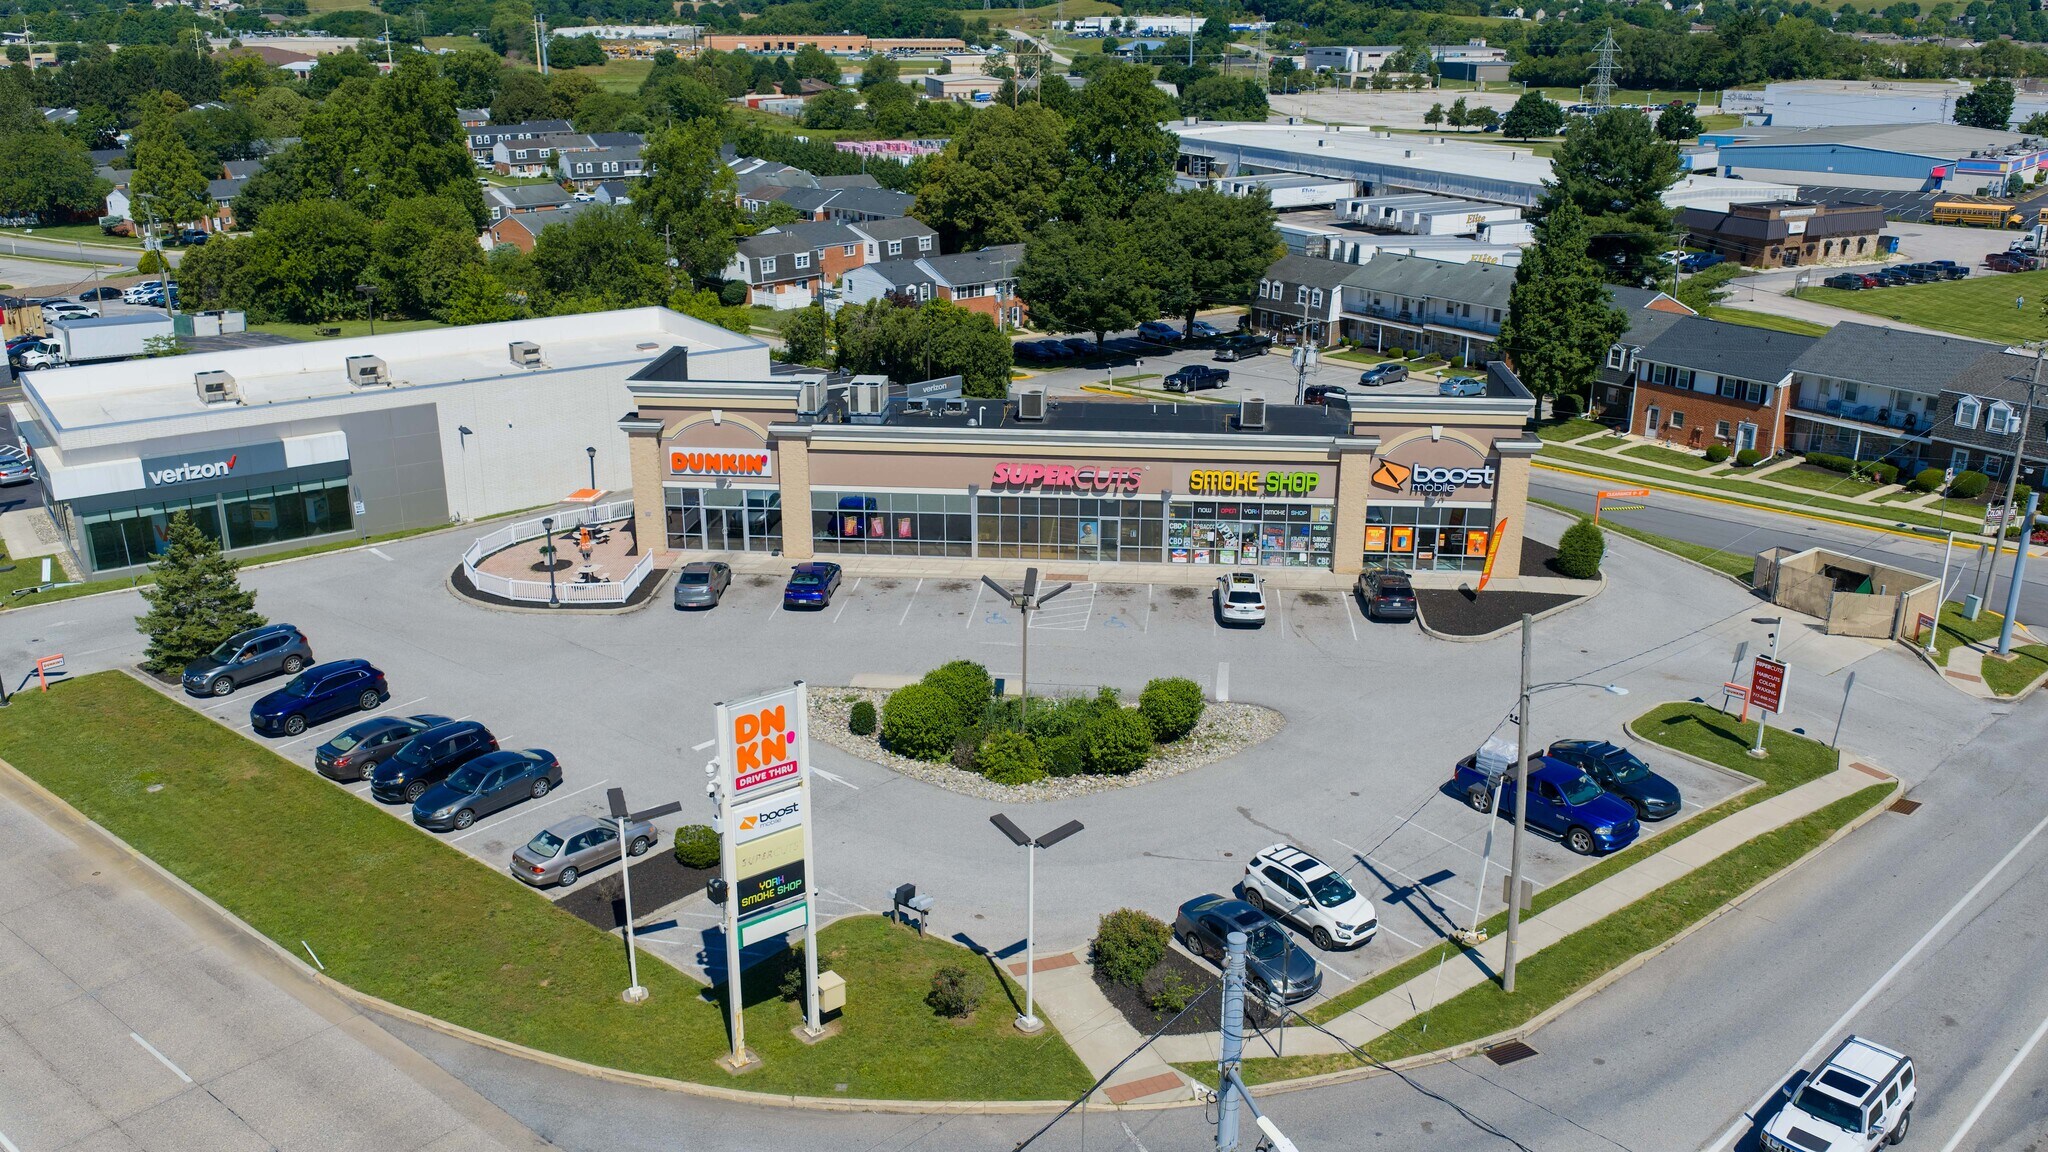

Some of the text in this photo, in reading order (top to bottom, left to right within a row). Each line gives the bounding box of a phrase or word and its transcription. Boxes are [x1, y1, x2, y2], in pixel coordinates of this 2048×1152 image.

[1466, 214, 1486, 224] Elite
[1471, 253, 1498, 265] Elite
[922, 383, 947, 393] verizon
[671, 452, 768, 475] DUNKIN'
[149, 461, 230, 485] verizon
[992, 462, 1144, 490] SUPERCUTS
[1413, 463, 1495, 484] boost
[1190, 470, 1320, 493] SMOKE SHOP
[1412, 482, 1457, 493] mobile
[1169, 537, 1183, 545] CBD
[1316, 557, 1331, 565] CBD
[1756, 661, 1784, 674] SUPERCUTS
[1756, 671, 1781, 683] HAIRCUTS
[1758, 678, 1776, 689] COLOR
[1755, 684, 1777, 696] WAXING
[735, 705, 785, 745] DN
[739, 764, 794, 787] DRIVE THRU
[759, 802, 799, 823] boost
[759, 817, 782, 828] mobile
[758, 875, 785, 891] YORK
[741, 879, 802, 907] SMOKE SHOP
